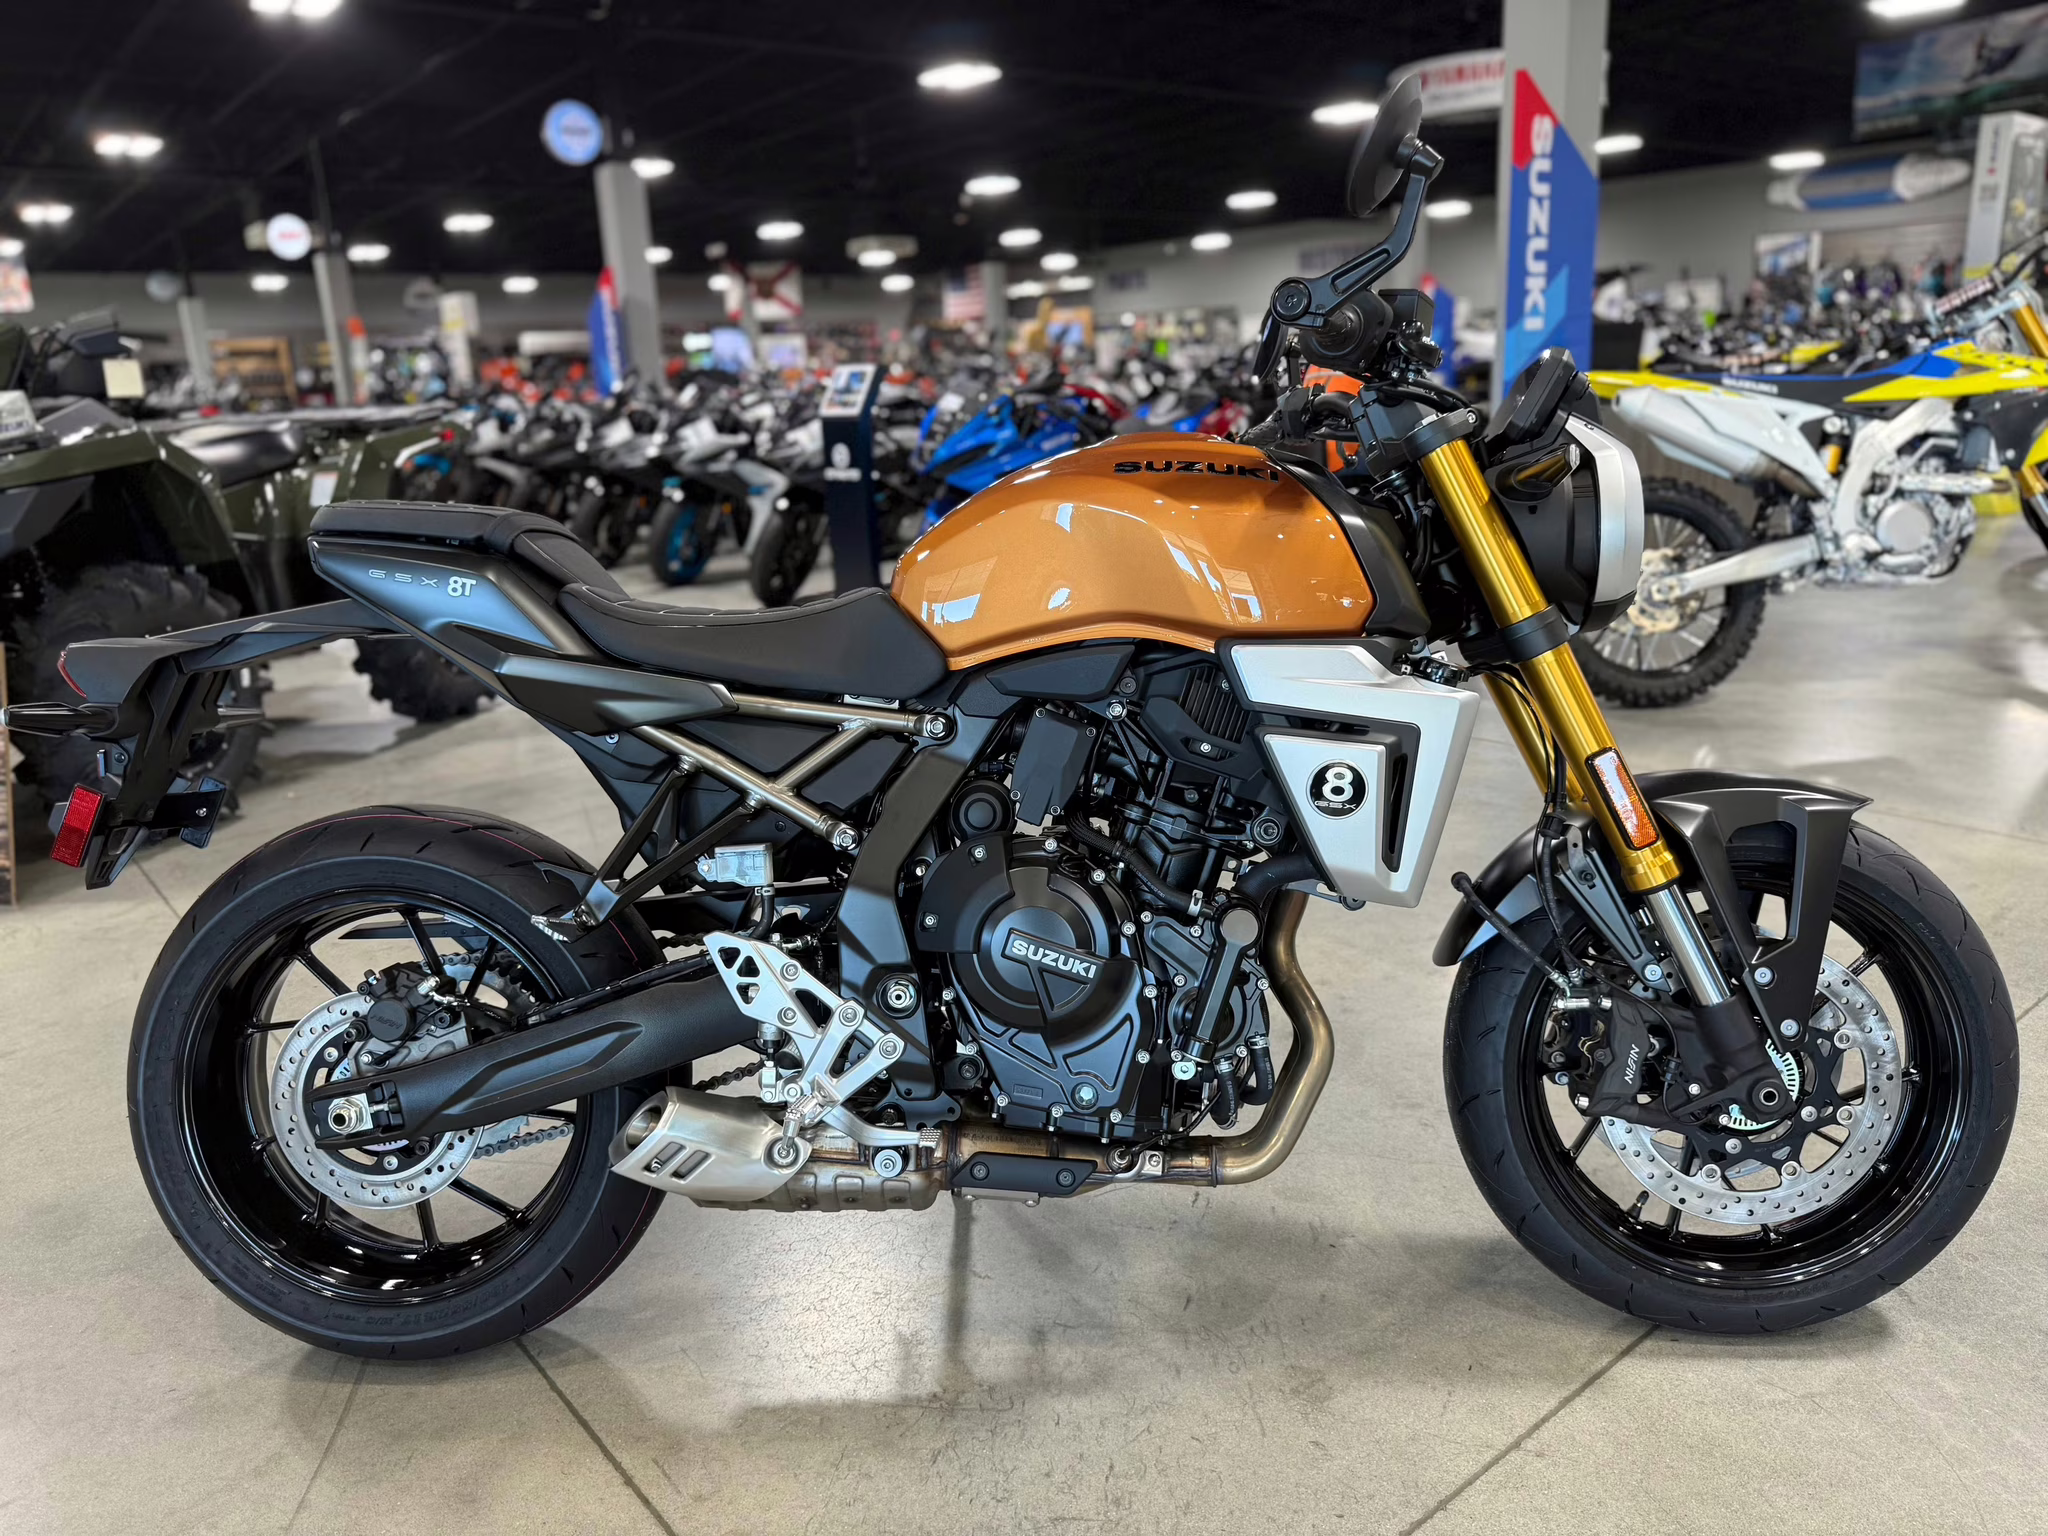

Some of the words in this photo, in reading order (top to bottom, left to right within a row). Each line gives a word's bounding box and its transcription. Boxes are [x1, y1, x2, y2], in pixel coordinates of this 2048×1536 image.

[1524, 113, 1555, 331] SUZUKI
[1113, 461, 1279, 483] SUZUKI
[368, 569, 439, 588] GSX
[447, 576, 477, 597] 8T
[1322, 766, 1354, 802] 8
[1314, 800, 1357, 810] GSX
[1011, 939, 1097, 979] SUZUKI
[1623, 1043, 1640, 1085] NISSIN
